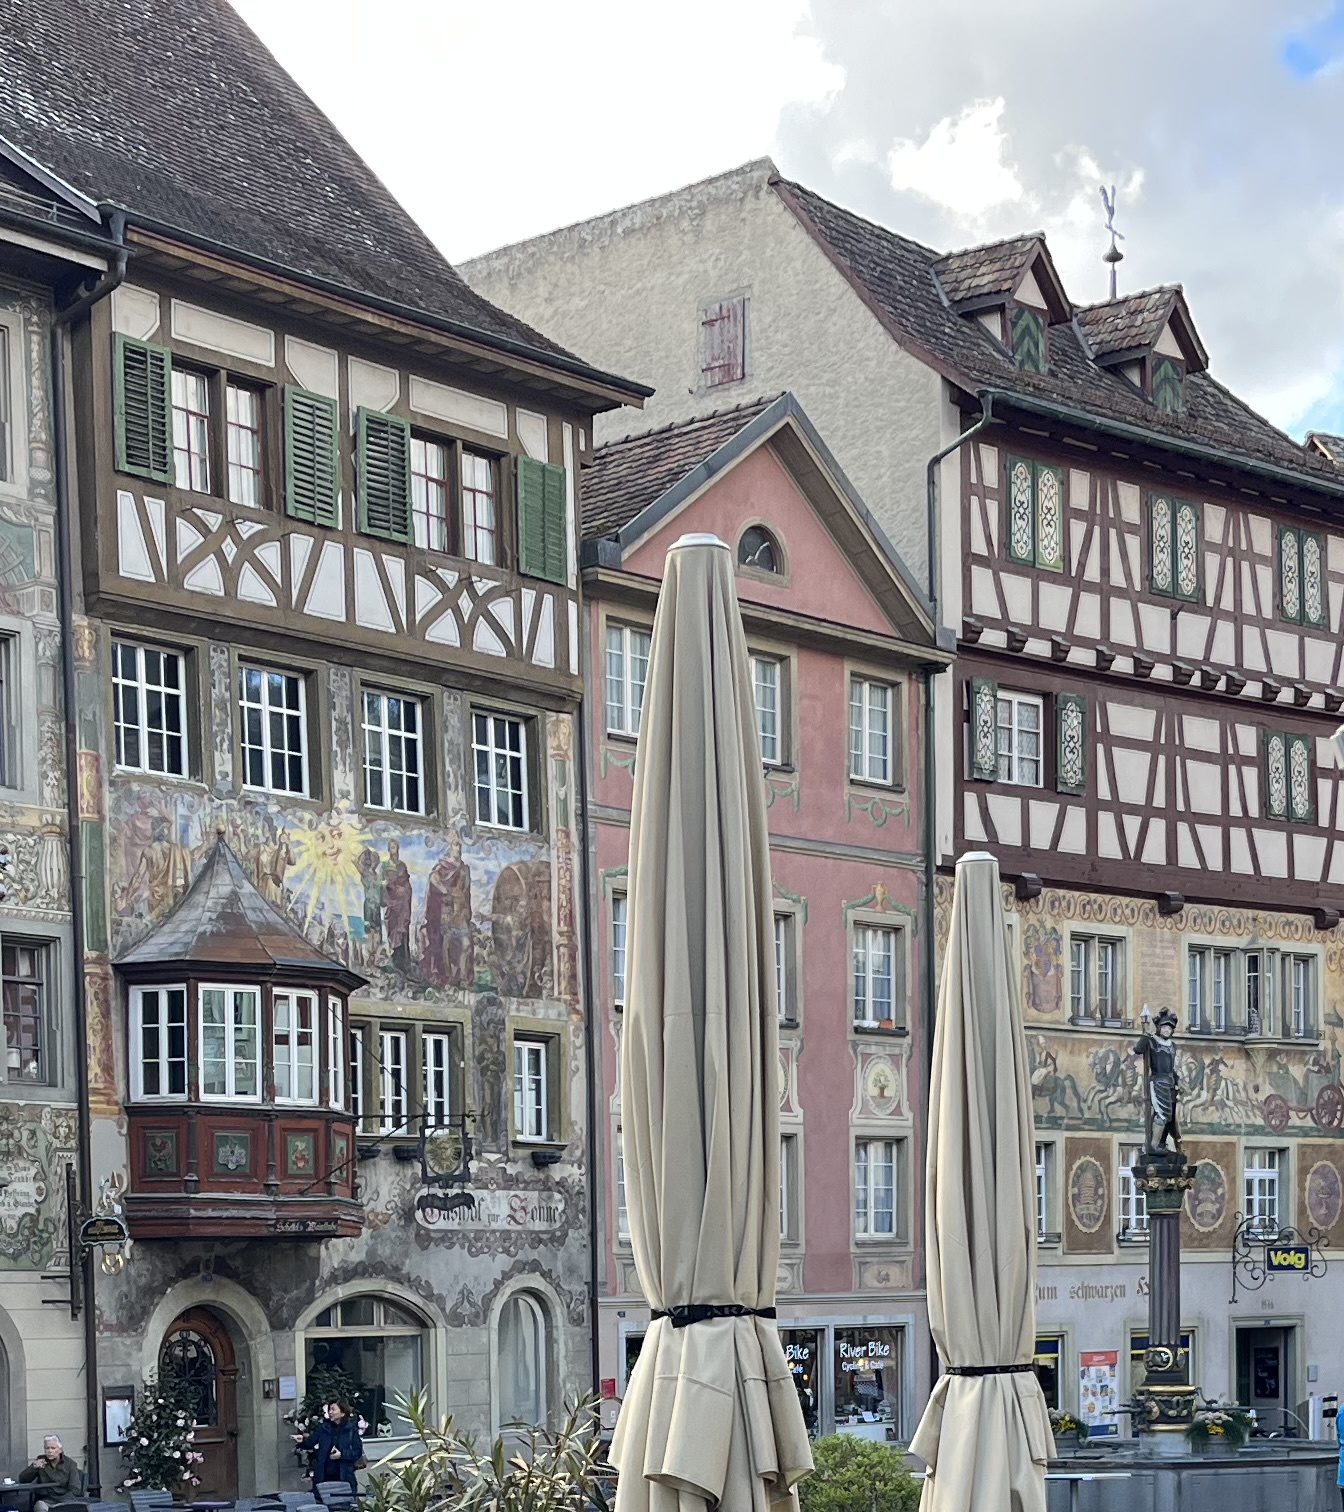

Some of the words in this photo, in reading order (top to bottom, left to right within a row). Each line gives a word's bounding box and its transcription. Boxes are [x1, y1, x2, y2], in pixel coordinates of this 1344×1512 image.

[506, 1194, 559, 1226] Sonne
[1269, 1250, 1306, 1269] Volg
[785, 1344, 810, 1360] Bike
[839, 1342, 867, 1358] River
[868, 1340, 890, 1357] Bike
